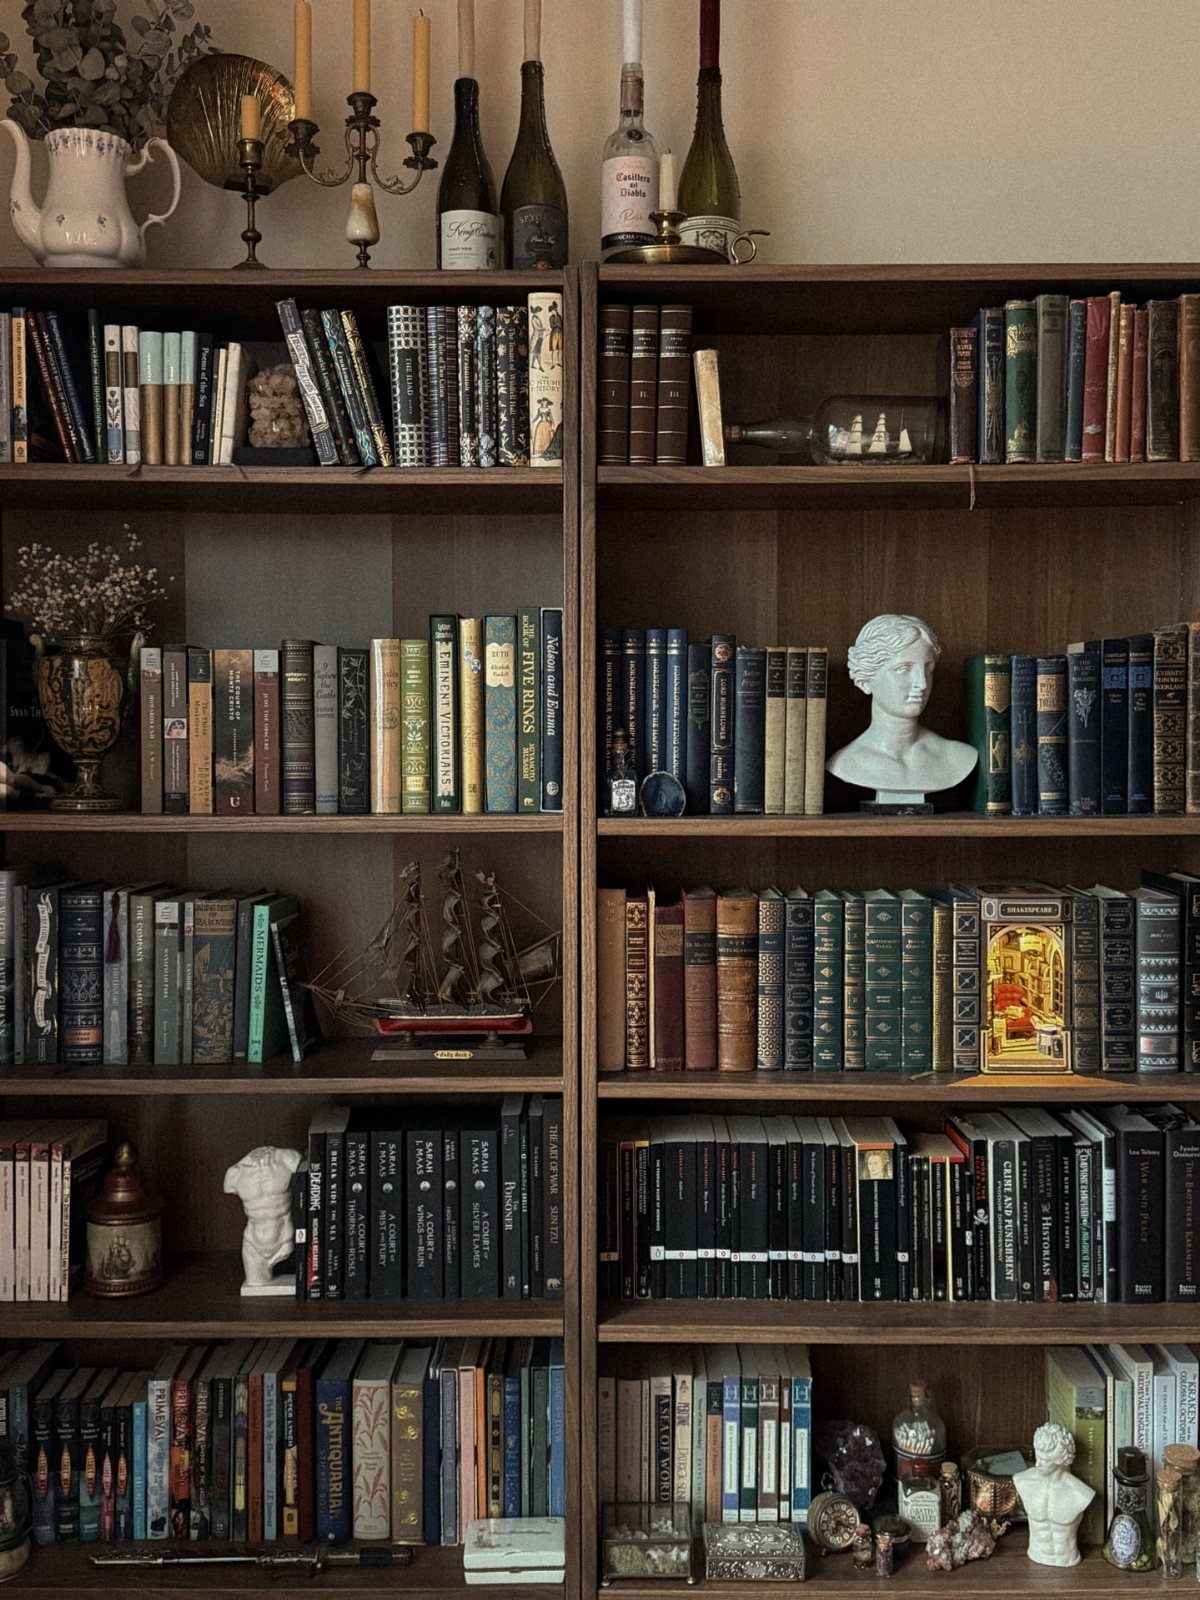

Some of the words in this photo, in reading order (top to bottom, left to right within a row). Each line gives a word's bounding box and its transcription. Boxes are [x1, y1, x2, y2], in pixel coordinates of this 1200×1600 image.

[616, 173, 651, 183] Casillero
[620, 188, 647, 198] Diablo
[508, 328, 516, 340] The
[201, 347, 210, 370] Poems
[438, 356, 445, 364] of
[508, 342, 516, 363] Tenant
[200, 371, 208, 382] of
[315, 351, 326, 370] Scarlet
[321, 372, 331, 391] Letter
[337, 351, 353, 395] Frankenstein
[405, 357, 413, 373] THE
[463, 349, 471, 391] Persuasion
[200, 381, 208, 394] the
[406, 374, 414, 396] ILIAD
[509, 373, 517, 399] Wildfell
[198, 395, 206, 408] Sea
[509, 401, 517, 415] Hall
[523, 637, 529, 648] OF
[546, 634, 559, 672] Nelson
[315, 671, 336, 680] Capture
[440, 651, 450, 708] EMINENT
[523, 650, 535, 686] FIVE
[315, 690, 336, 699] Castle
[320, 680, 331, 688] the
[546, 674, 558, 695] and
[235, 711, 241, 721] OF
[523, 688, 535, 734] RINGS
[546, 698, 558, 736] Emma
[652, 713, 660, 728] THE
[652, 729, 660, 752] HAPPY
[673, 719, 681, 745] FLYING
[440, 712, 451, 785] VICTORIANS
[255, 930, 266, 992] MERMAIDS
[550, 1125, 558, 1143] THE
[388, 1143, 396, 1175] SARAH
[416, 1148, 424, 1175] MAAS
[425, 1141, 433, 1173] SARAH
[550, 1143, 558, 1160] ART
[329, 1150, 337, 1179] BREAK
[348, 1150, 356, 1177] MAAS
[379, 1150, 387, 1177] MAAS
[550, 1161, 558, 1173] OF
[1140, 1161, 1149, 1184] WAR
[1185, 1162, 1193, 1178] THE
[550, 1173, 558, 1193] WAR
[1004, 1160, 1013, 1193] CRIME
[309, 1172, 321, 1211] DEADING
[329, 1183, 337, 1205] WIDE
[1140, 1189, 1148, 1208] AND
[426, 1211, 434, 1219] A
[504, 1181, 516, 1231] POISONER
[1004, 1195, 1013, 1216] AND
[1185, 1182, 1193, 1227] BROTHERS
[348, 1199, 356, 1236] THORNS
[358, 1213, 365, 1221] A
[379, 1209, 387, 1231] MIST
[388, 1213, 396, 1221] A
[416, 1204, 424, 1234] WINGS
[472, 1202, 480, 1231] SILVER
[1140, 1212, 1149, 1243] PEACE
[329, 1225, 337, 1241] SEA
[388, 1223, 396, 1254] COURT
[426, 1221, 434, 1252] COURT
[378, 1243, 387, 1266] FURY
[416, 1246, 424, 1267] RUIN
[472, 1233, 480, 1268] FLAMES
[1004, 1219, 1014, 1282] PUNISHMENT
[1042, 1216, 1052, 1276] HISTORIAN
[1185, 1231, 1193, 1282] KARAMAZOV
[348, 1248, 356, 1277] ROSES
[660, 1396, 670, 1404] A
[1187, 1381, 1196, 1424] KRAKEN
[155, 1388, 166, 1442] PRIMEVAL
[660, 1406, 670, 1431] SEA
[660, 1434, 670, 1452] OF
[319, 1402, 344, 1520] ANTIQUARIAN
